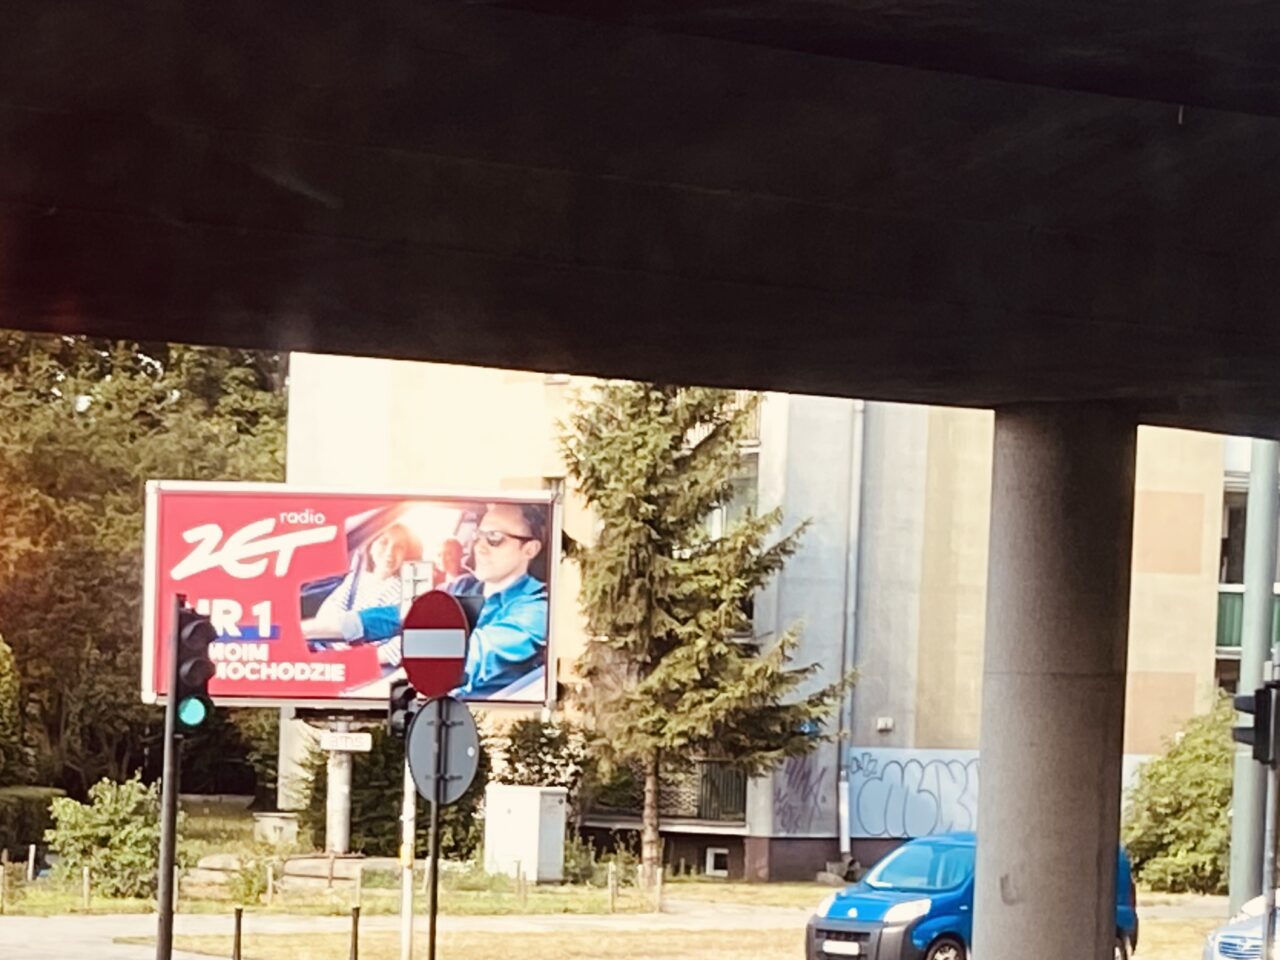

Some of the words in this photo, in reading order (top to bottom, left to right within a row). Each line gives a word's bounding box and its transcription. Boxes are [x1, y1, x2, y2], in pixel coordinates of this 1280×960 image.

[280, 509, 325, 525] radio
[170, 517, 338, 581] ZET
[252, 601, 272, 638] 1
